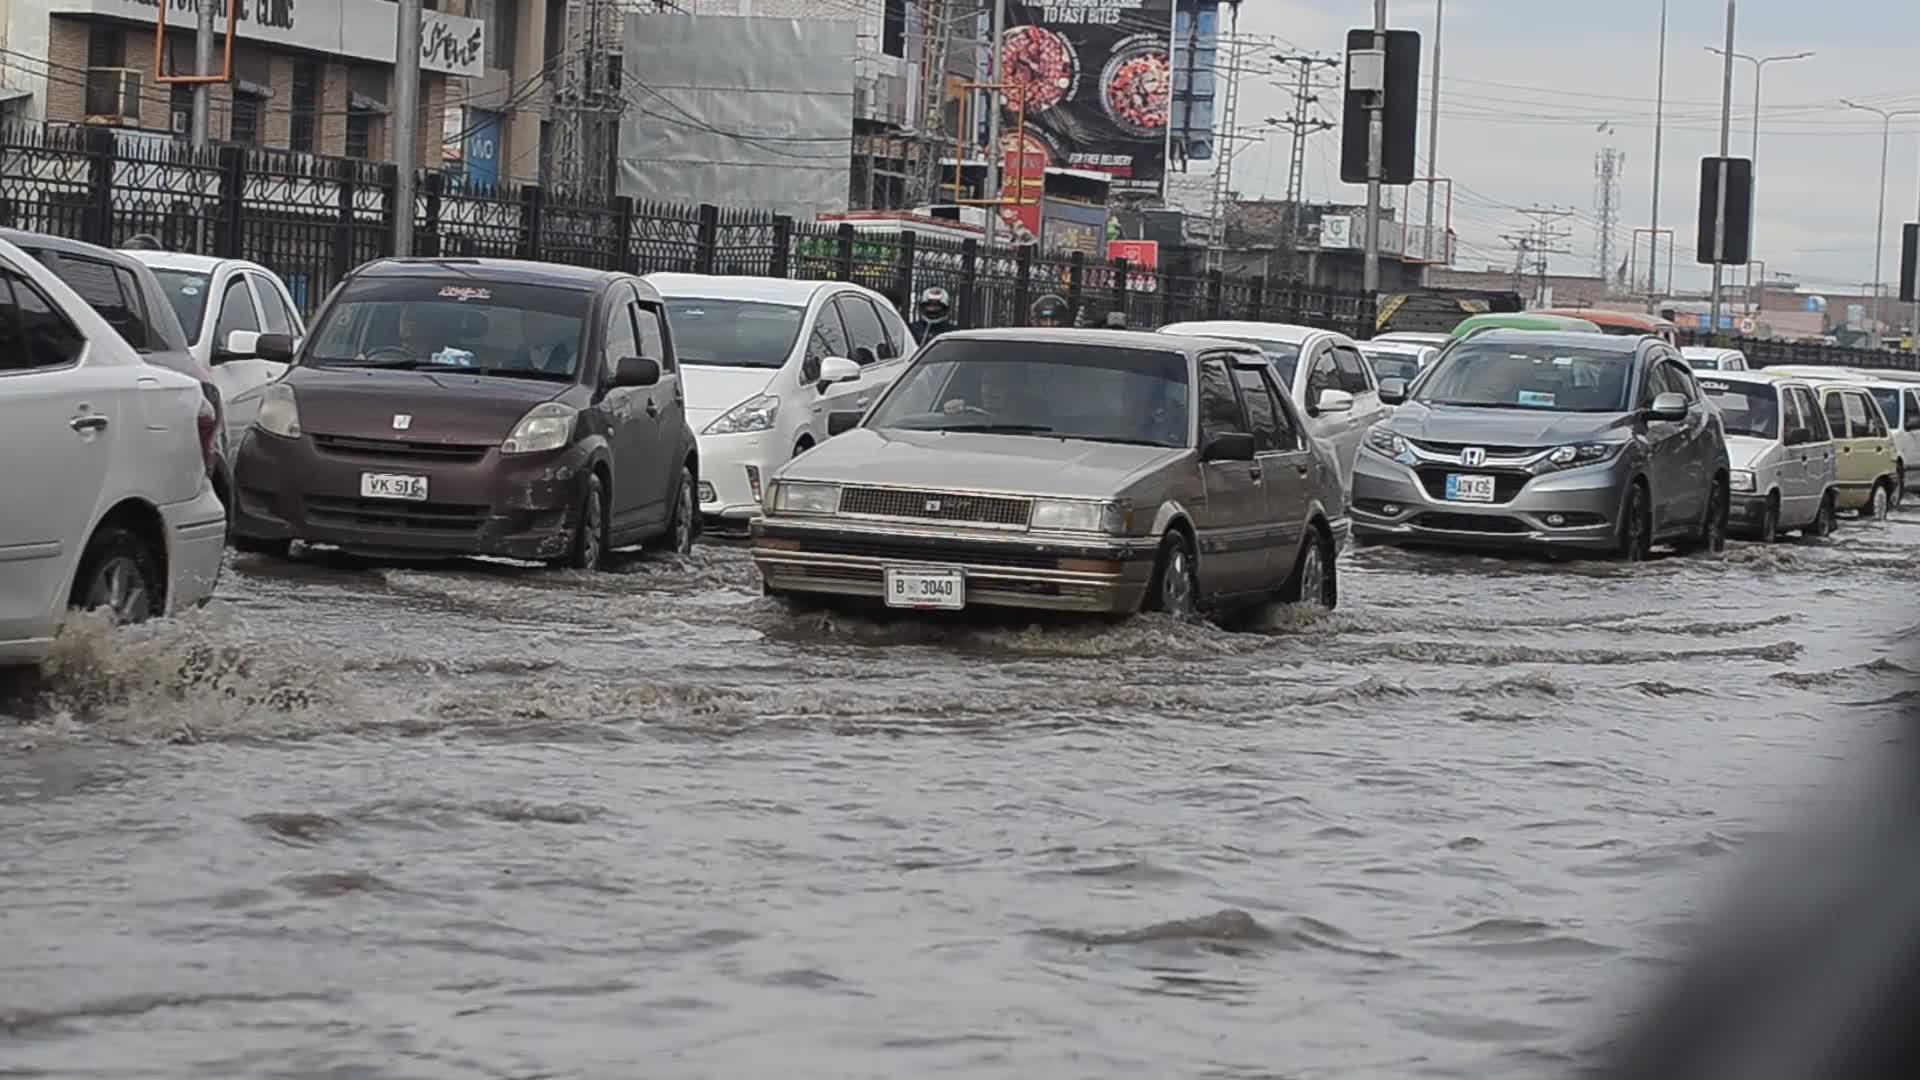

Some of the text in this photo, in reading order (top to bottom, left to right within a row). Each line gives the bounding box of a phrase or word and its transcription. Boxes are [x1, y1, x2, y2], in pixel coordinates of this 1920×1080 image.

[1043, 6, 1121, 24] TO FAST BITES
[370, 479, 390, 491] VK
[896, 579, 953, 596] B 3040
